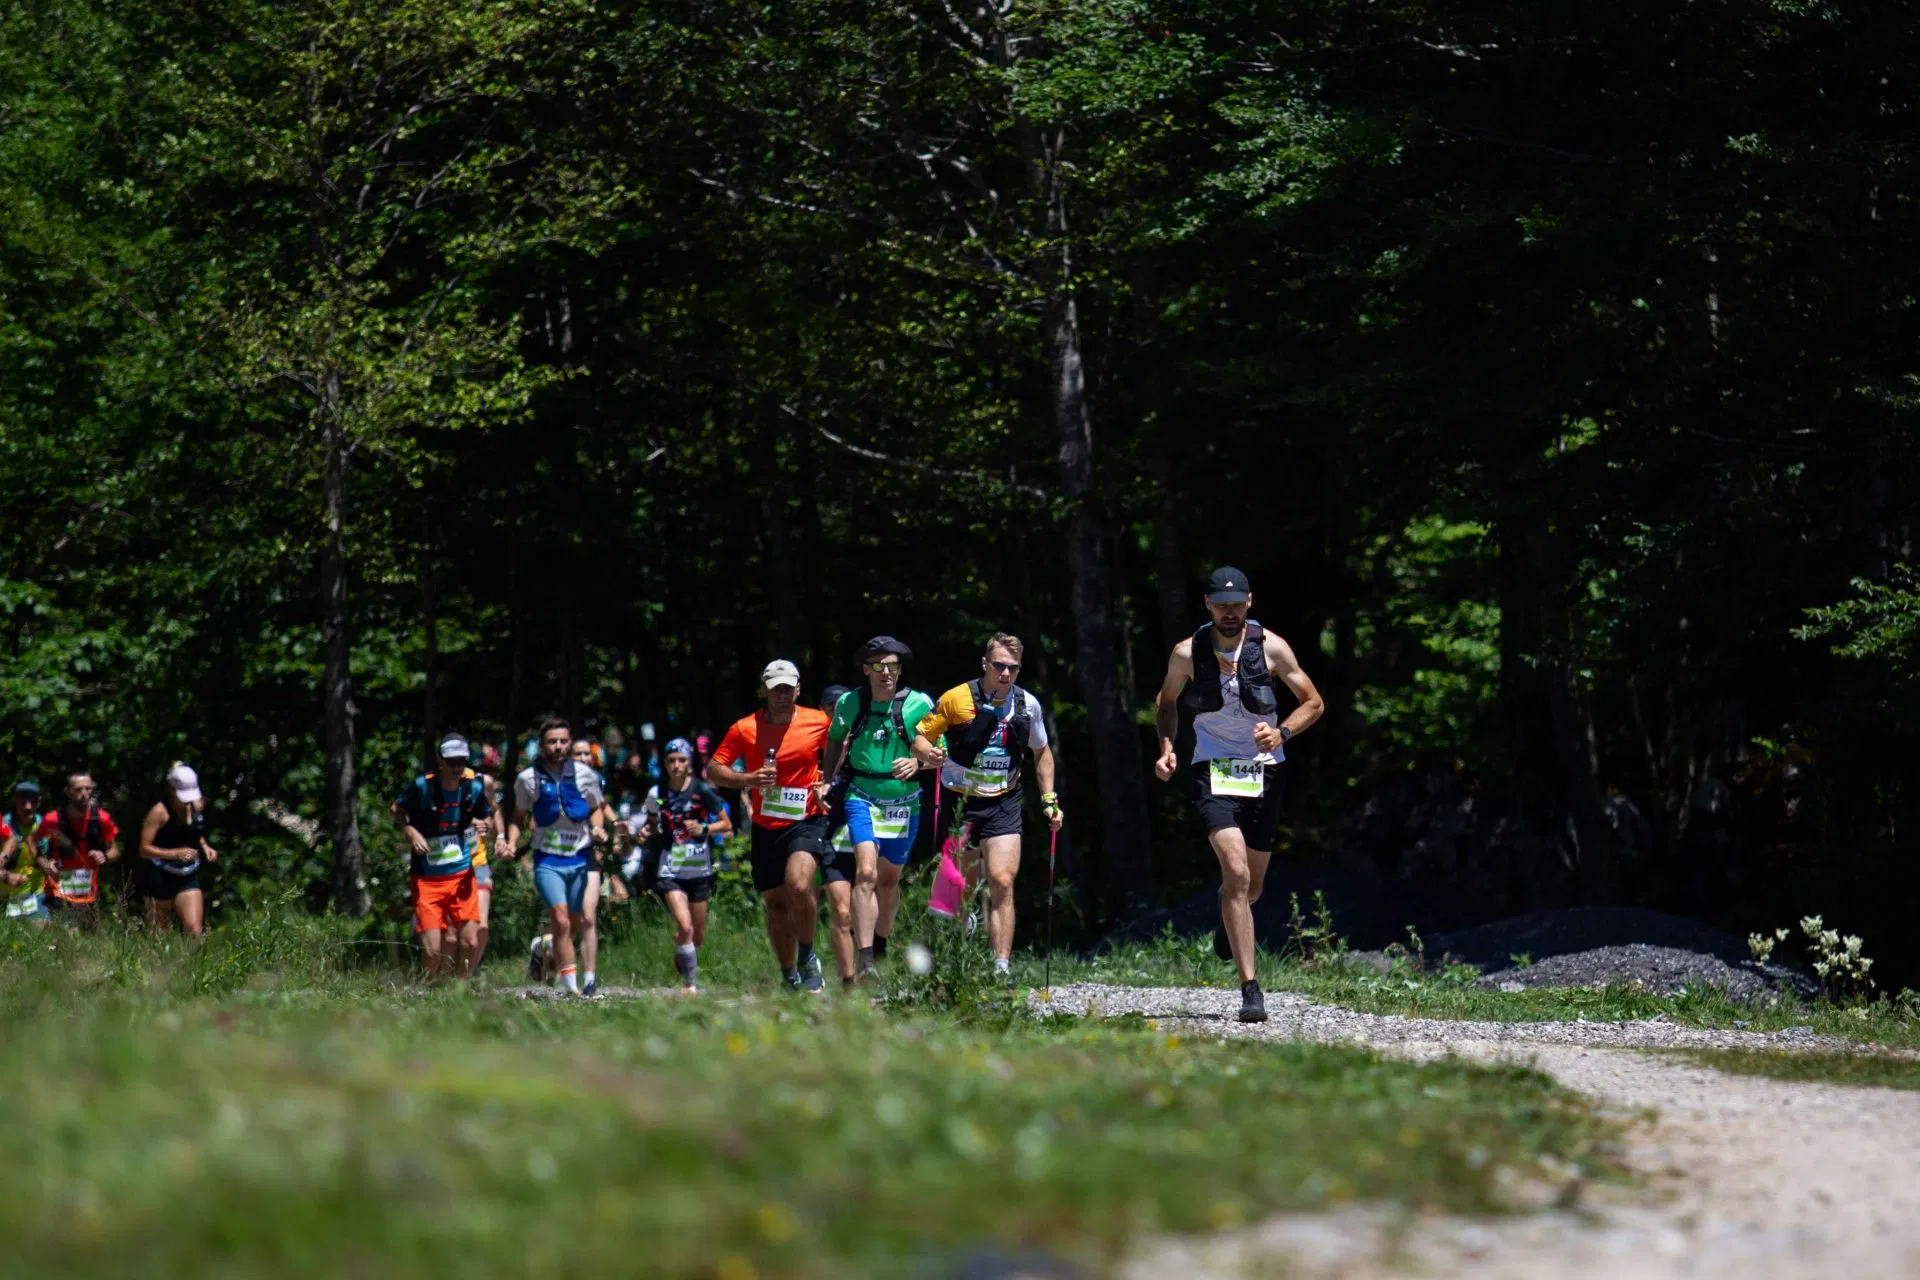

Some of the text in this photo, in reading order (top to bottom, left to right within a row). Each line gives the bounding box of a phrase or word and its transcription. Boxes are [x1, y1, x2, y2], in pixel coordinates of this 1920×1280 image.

[985, 761, 1008, 769] 1076
[1234, 764, 1262, 774] 1444
[783, 792, 806, 801] 1282
[887, 810, 909, 819] 1483
